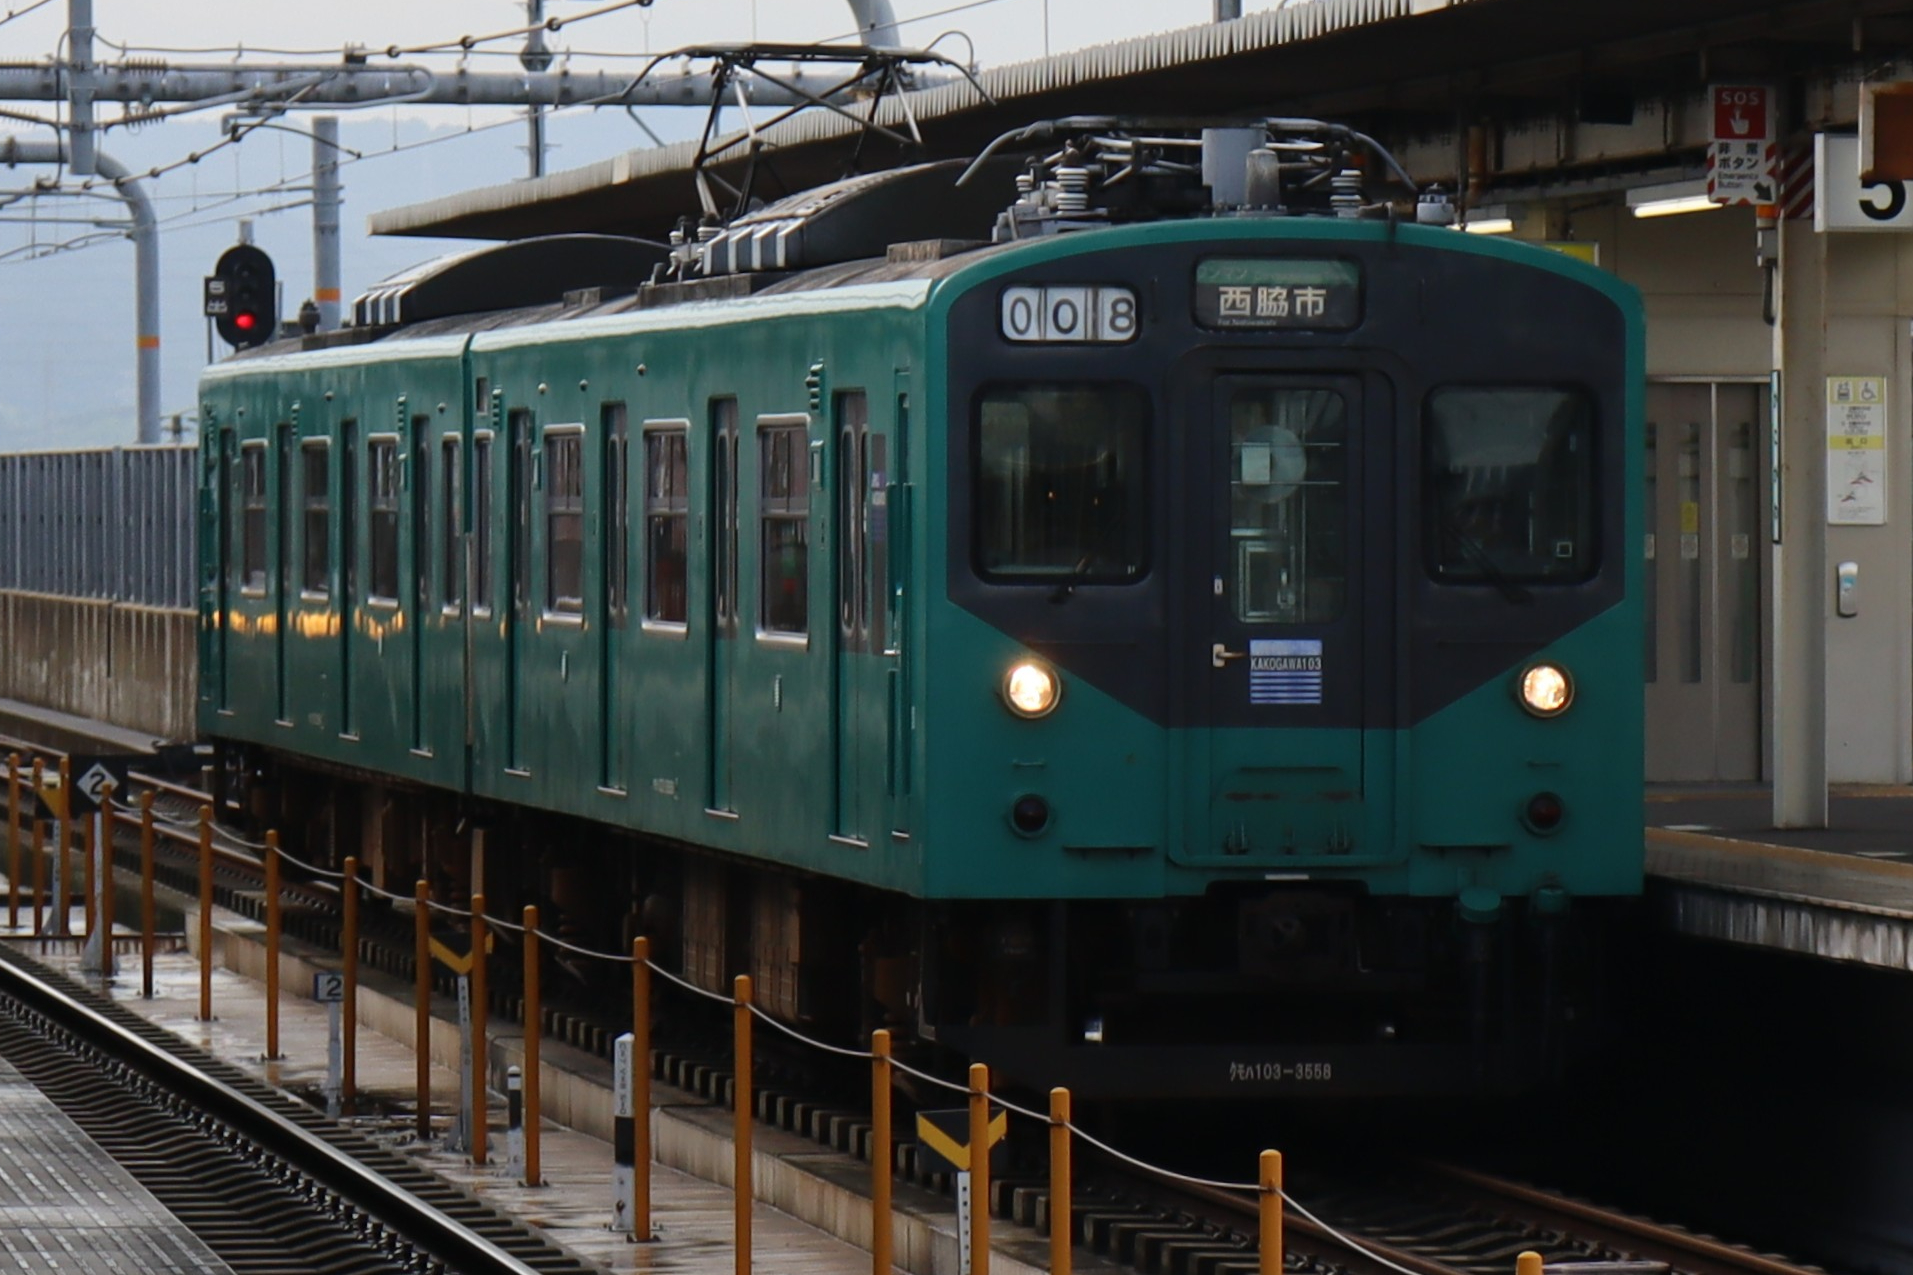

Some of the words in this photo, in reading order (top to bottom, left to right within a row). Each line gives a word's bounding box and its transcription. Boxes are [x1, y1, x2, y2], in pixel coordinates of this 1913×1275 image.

[1721, 91, 1759, 106] SOS
[1718, 157, 1759, 170] ボタン
[1859, 180, 1906, 221] 5
[1218, 286, 1327, 317] 西脇市
[1251, 657, 1322, 671] KAKOGAWA103
[90, 772, 106, 795] 2
[326, 977, 343, 997] 2
